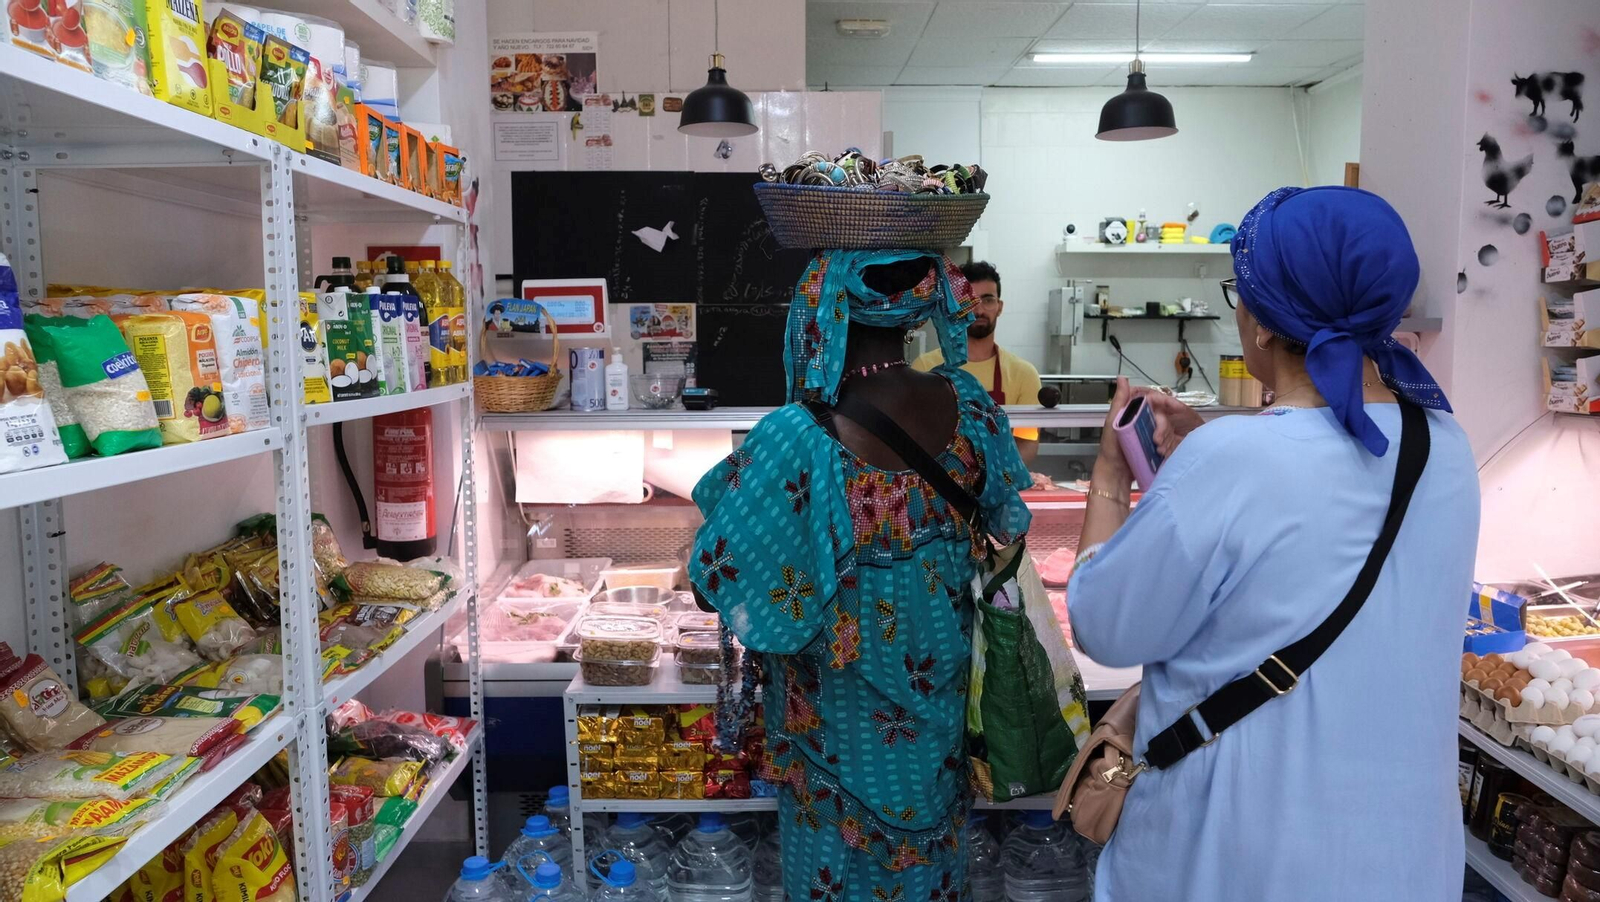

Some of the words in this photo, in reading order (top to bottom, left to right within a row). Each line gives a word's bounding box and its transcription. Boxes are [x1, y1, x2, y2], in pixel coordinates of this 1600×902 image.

[276, 27, 286, 35] DE
[379, 300, 396, 311] PULEVA
[402, 301, 417, 311] PULEVA
[236, 347, 258, 357] Almidón
[690, 728, 697, 736] 3
